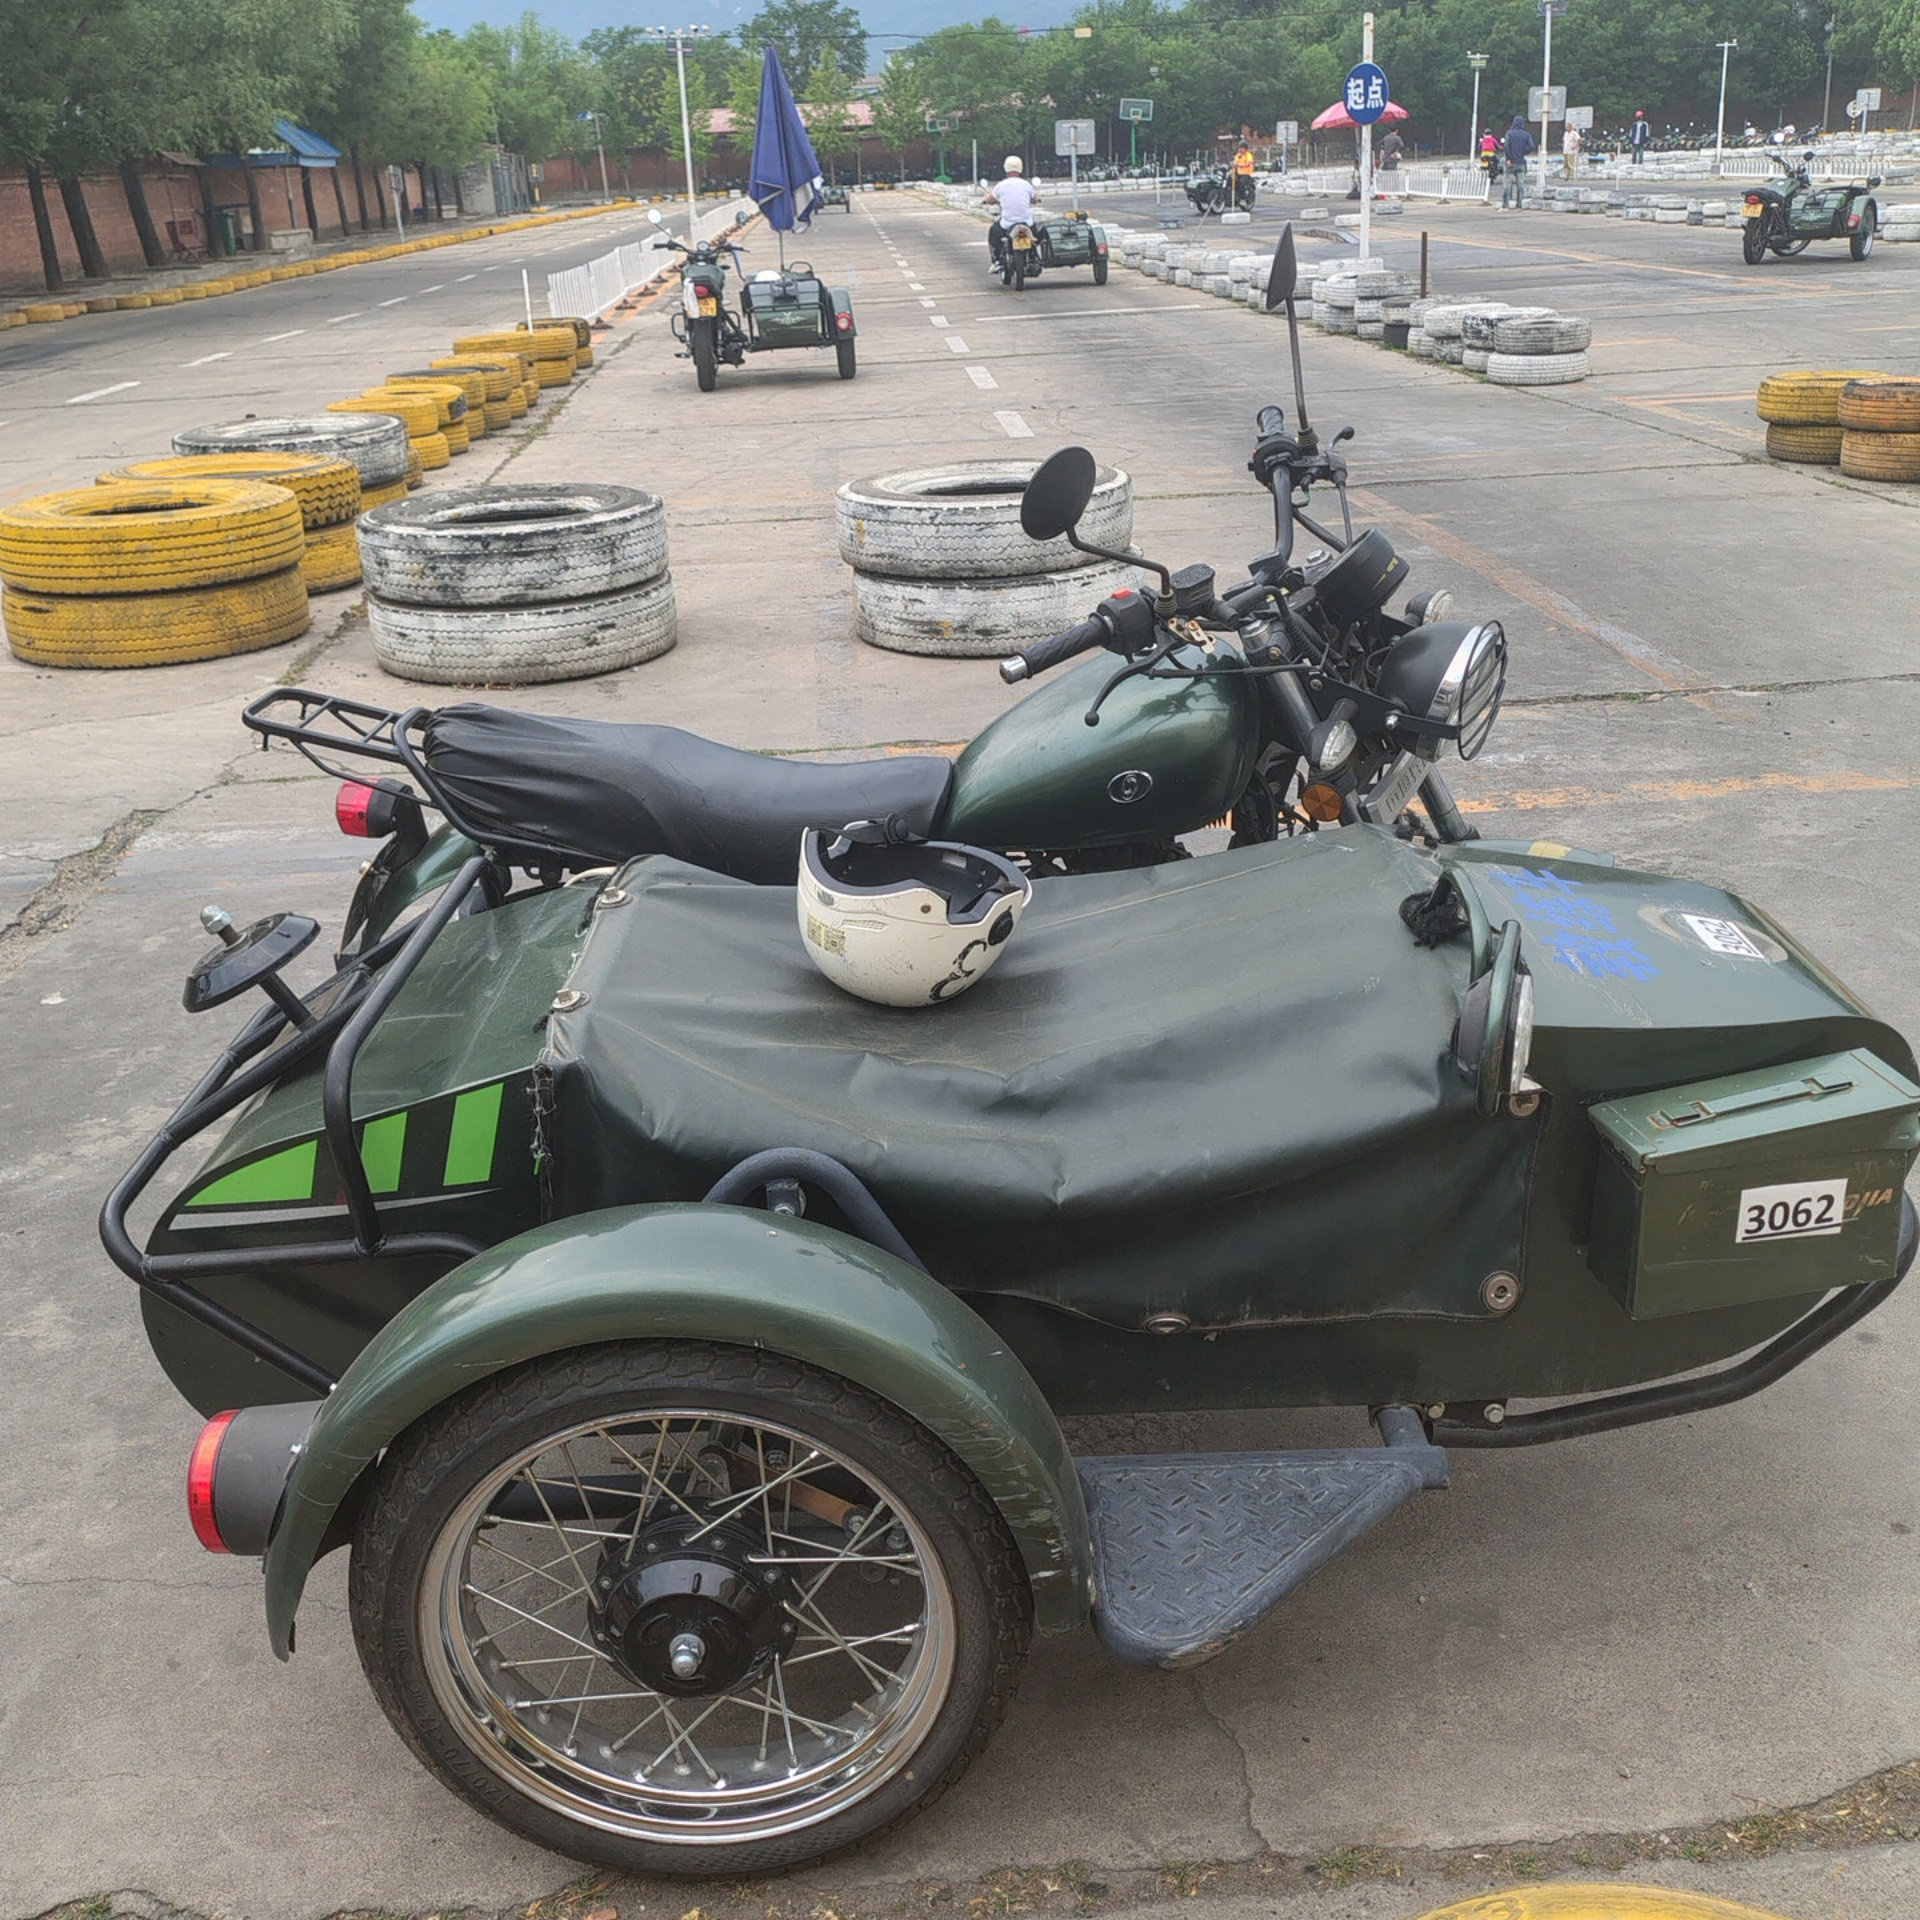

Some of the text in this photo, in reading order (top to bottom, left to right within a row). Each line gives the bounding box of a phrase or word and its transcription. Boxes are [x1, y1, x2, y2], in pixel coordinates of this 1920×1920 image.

[1347, 75, 1384, 110] 起点
[1697, 919, 1752, 954] 3062
[1744, 1194, 1835, 1235] 3062
